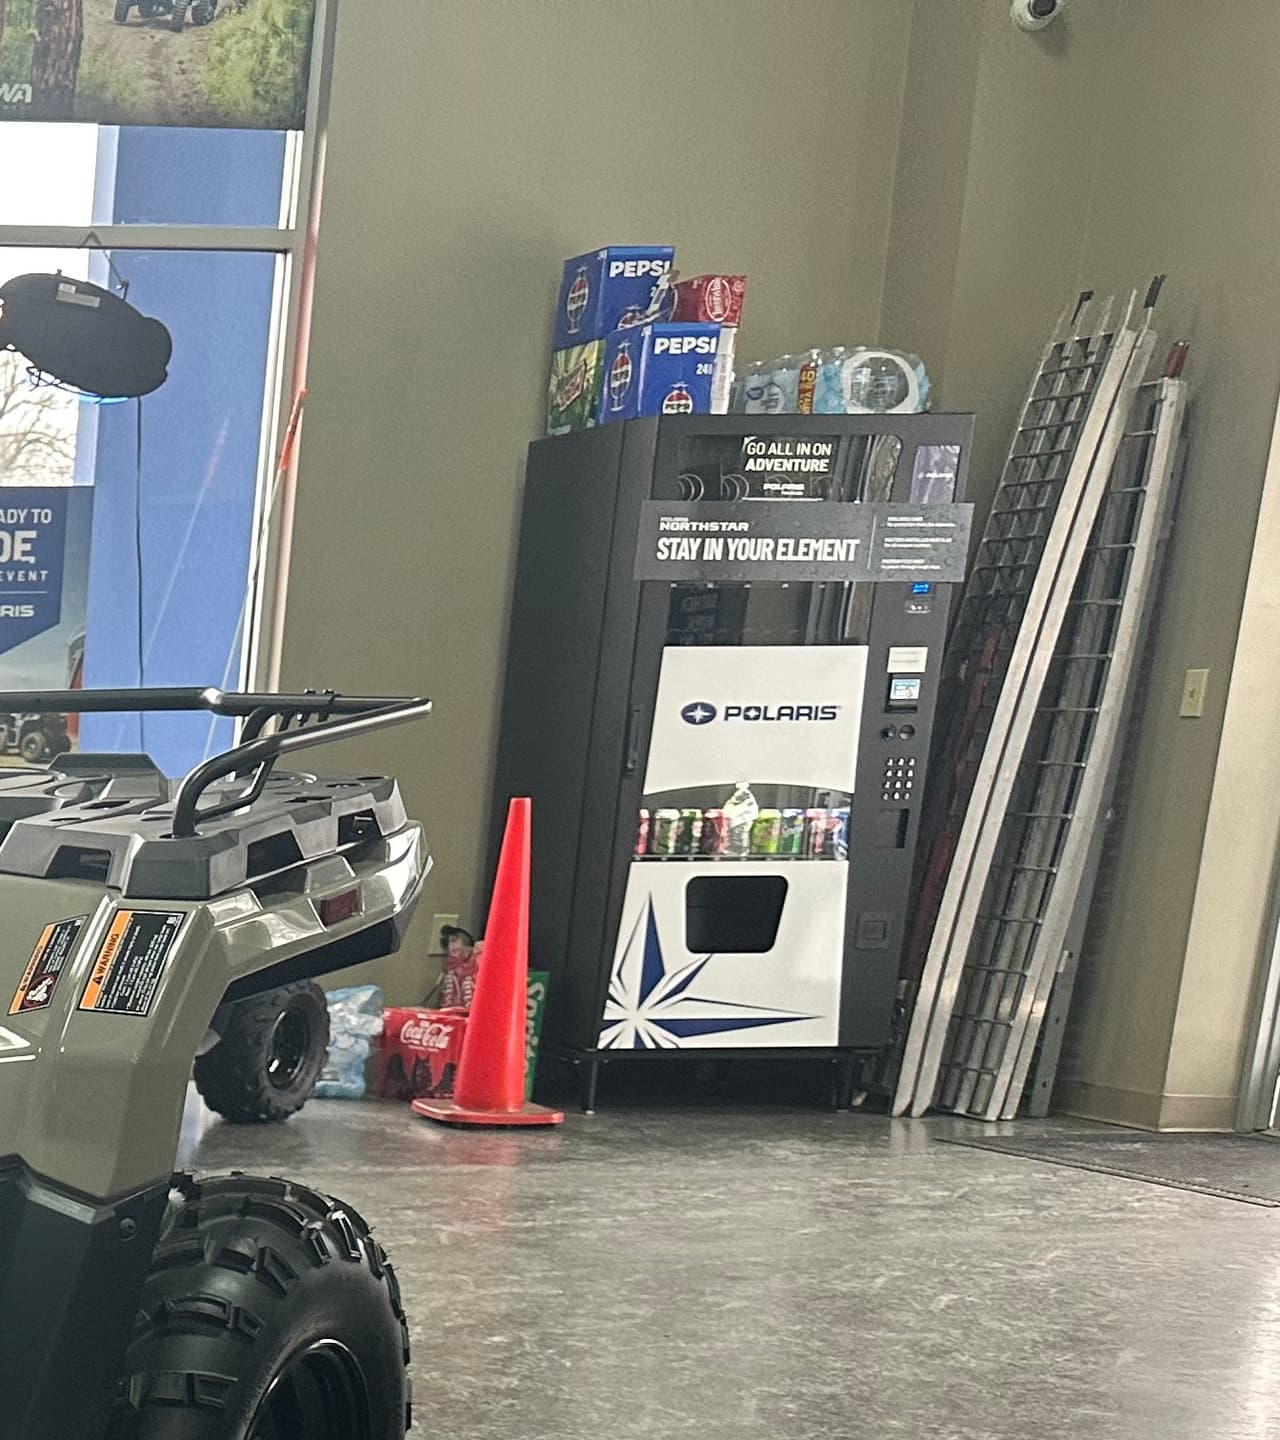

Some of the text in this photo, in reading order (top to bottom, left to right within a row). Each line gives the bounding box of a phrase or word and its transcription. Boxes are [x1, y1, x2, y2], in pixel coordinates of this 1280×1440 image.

[609, 260, 671, 278] PEPSI
[654, 336, 717, 355] PEPSI
[747, 442, 833, 456] GO ALL IN ON
[745, 458, 830, 472] ADVENTURE
[31, 508, 52, 524] TO
[659, 522, 749, 532] NORTHSTAR
[656, 537, 702, 561] STAY
[702, 538, 725, 561] IN
[727, 538, 776, 561] YOUR
[775, 538, 861, 562] ELEMENT
[724, 704, 838, 721] POLARIS
[96, 932, 121, 976] WARNING
[400, 1019, 454, 1050] Coca-Cola
